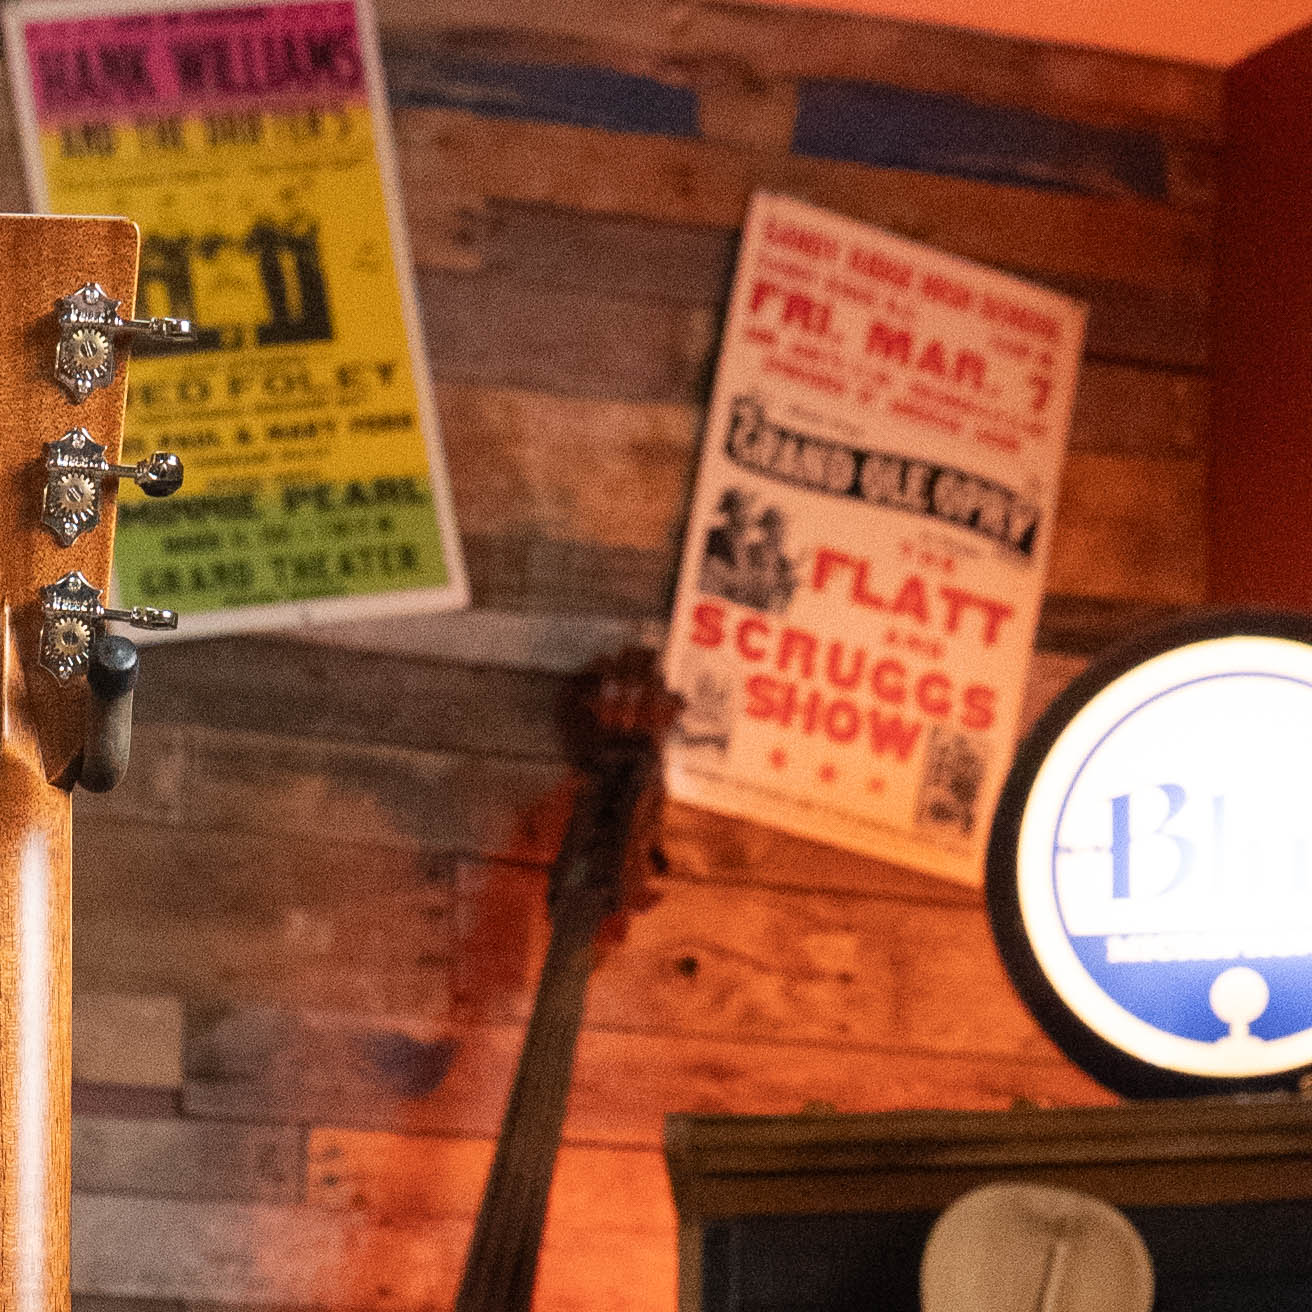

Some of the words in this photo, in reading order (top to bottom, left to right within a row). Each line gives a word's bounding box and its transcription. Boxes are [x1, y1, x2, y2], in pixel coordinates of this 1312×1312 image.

[226, 355, 401, 402] FOLEY
[808, 543, 1015, 652] FLATT
[689, 595, 1000, 739] SCRUGGS
[741, 667, 924, 769] SHOW
